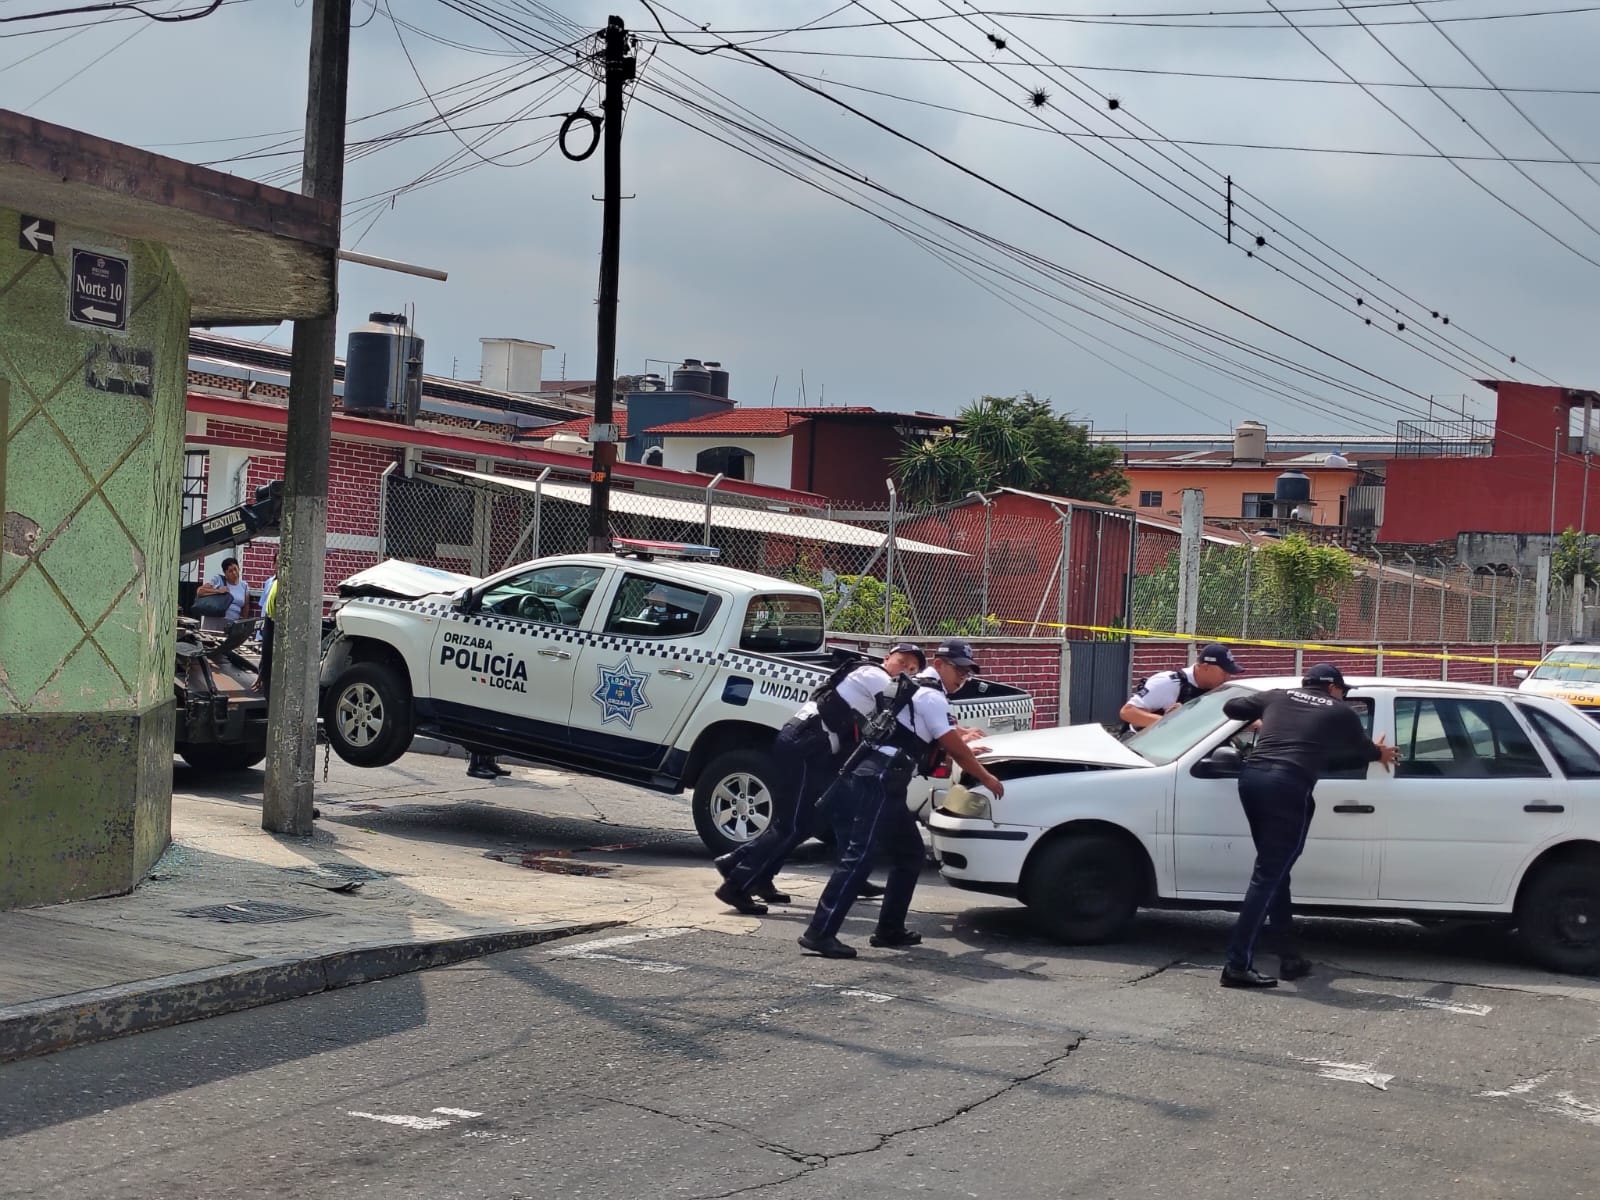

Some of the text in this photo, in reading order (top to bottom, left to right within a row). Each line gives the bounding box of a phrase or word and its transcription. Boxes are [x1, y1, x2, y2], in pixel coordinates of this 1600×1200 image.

[76, 274, 106, 298] Norte
[110, 283, 122, 301] 10
[210, 511, 241, 529] CENTURY
[443, 632, 493, 650] ORIZABA
[440, 645, 528, 681] POLICÍA
[489, 676, 527, 693] LOCAL
[610, 677, 632, 688] LOCAL
[760, 680, 809, 704] UNIDAD
[1286, 690, 1333, 706] PERITOS
